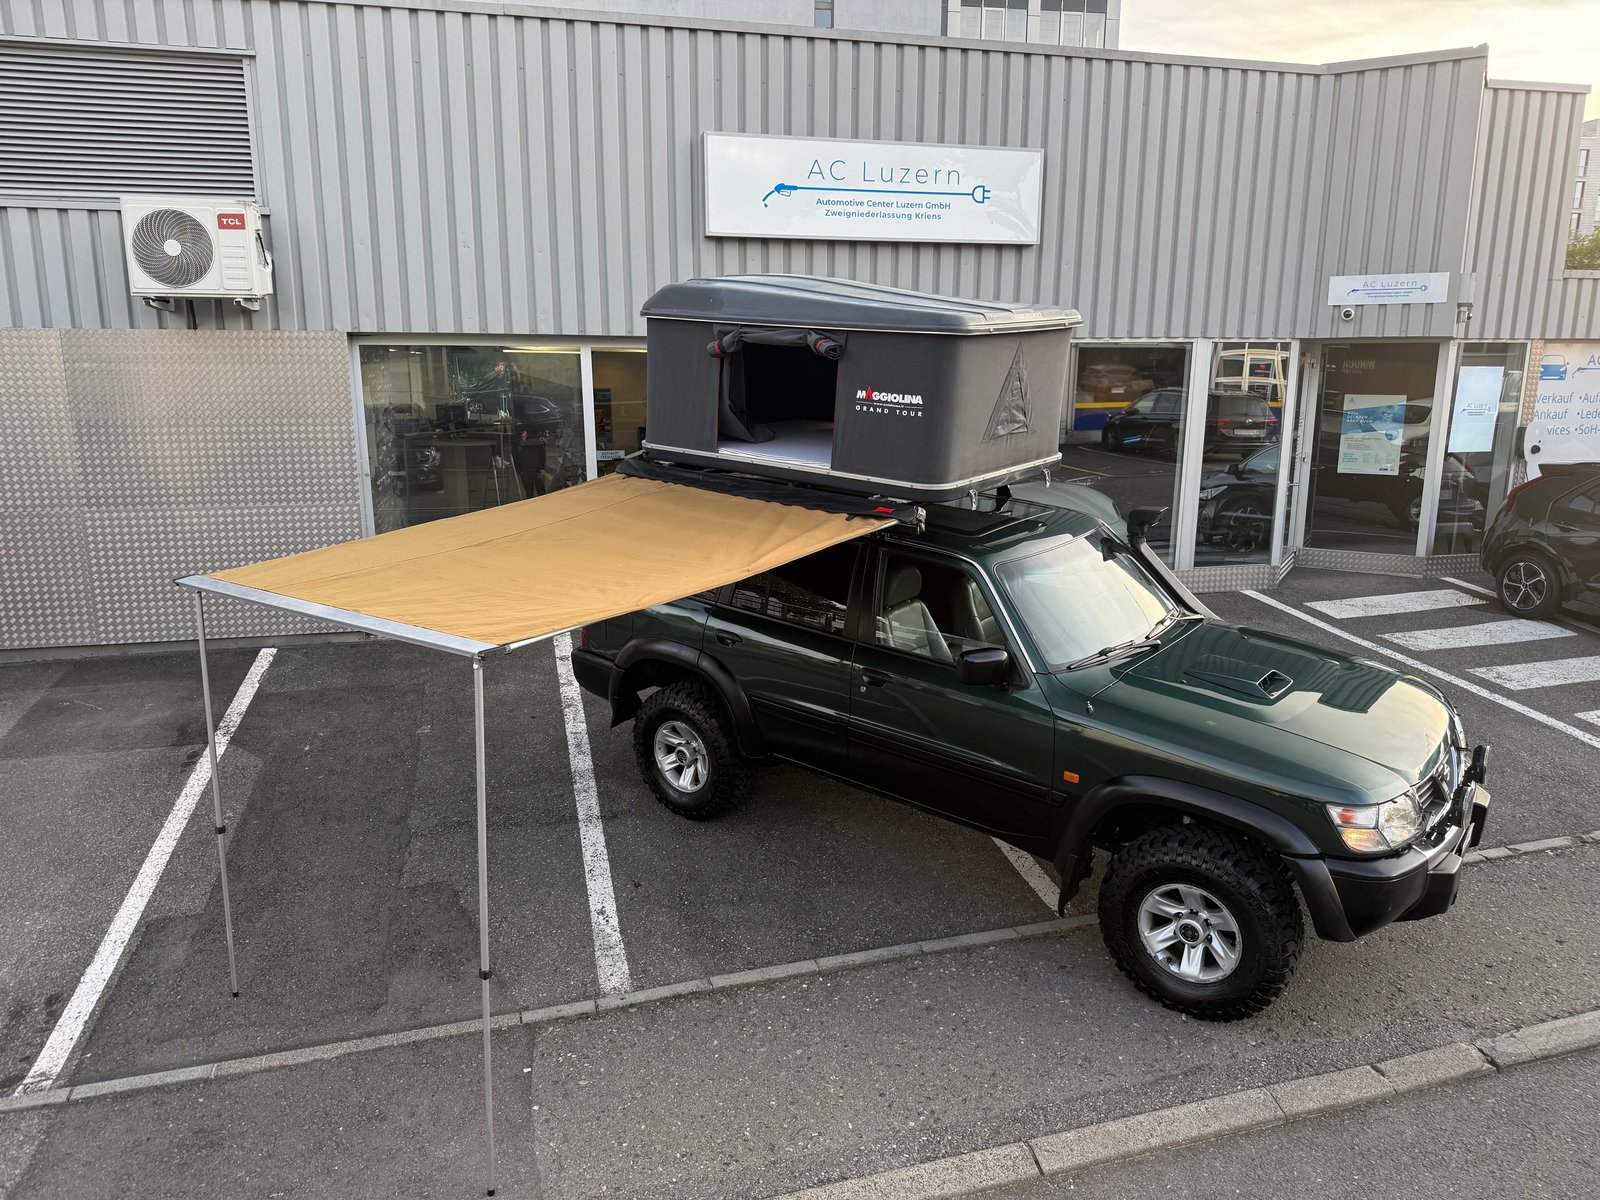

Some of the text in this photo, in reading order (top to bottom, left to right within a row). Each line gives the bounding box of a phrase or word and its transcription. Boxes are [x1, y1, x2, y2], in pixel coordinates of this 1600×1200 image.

[807, 159, 961, 186] AC Luzern
[815, 198, 951, 210] Automotive Center Luzern GmbH
[824, 209, 942, 220] Zweigniederlassung Kriens
[1362, 280, 1418, 288] AC Luzern
[856, 386, 923, 404] MAGGIOLINA
[1536, 392, 1574, 404] Verkauf
[855, 405, 923, 417] GRAND TOUR
[1533, 408, 1568, 420] Ankauf
